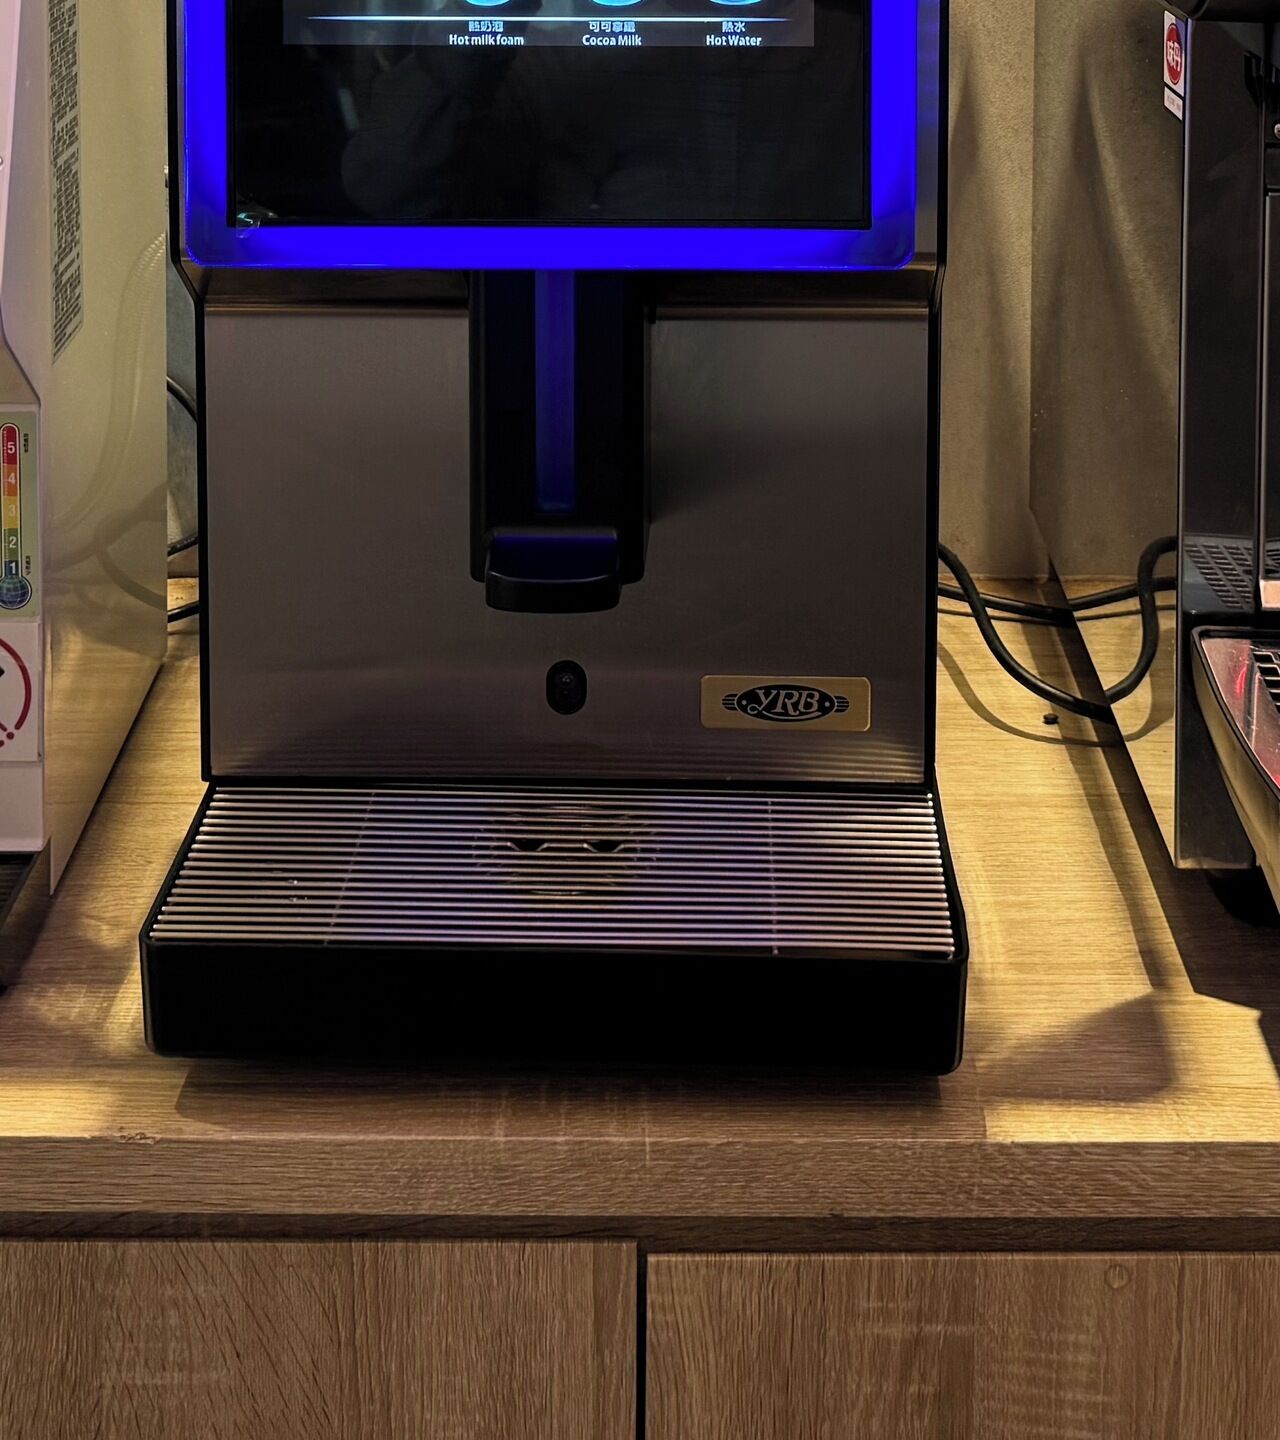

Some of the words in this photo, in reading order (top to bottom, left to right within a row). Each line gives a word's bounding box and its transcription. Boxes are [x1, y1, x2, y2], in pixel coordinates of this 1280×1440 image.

[722, 20, 745, 32] 熱水
[448, 34, 469, 45] Hot
[469, 34, 494, 45] milk
[495, 34, 524, 45] foam
[582, 35, 617, 46] Cocoa
[618, 34, 642, 46] Milk
[705, 34, 727, 45] Hot
[728, 35, 762, 46] Water
[7, 441, 16, 453] 5
[7, 472, 16, 484] 4
[8, 504, 16, 516] 3
[8, 536, 17, 549] 2
[9, 562, 16, 574] 1
[748, 689, 820, 716] YRB
